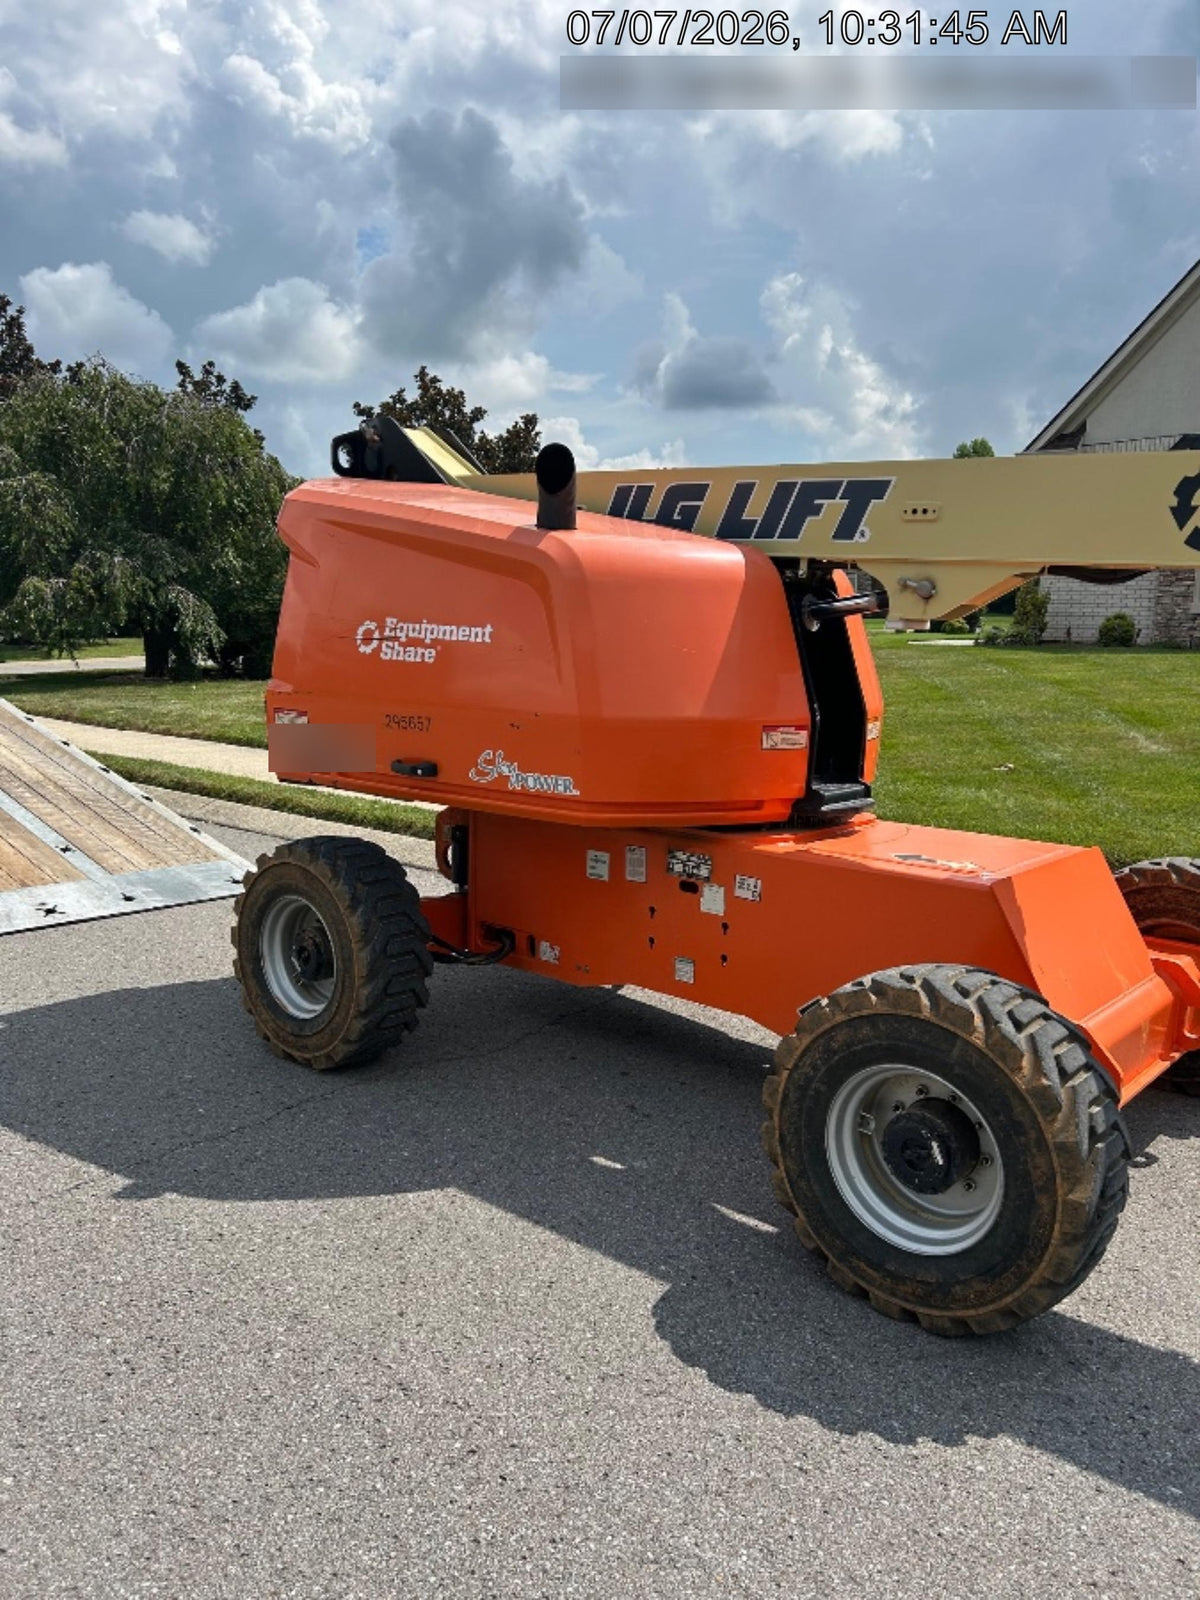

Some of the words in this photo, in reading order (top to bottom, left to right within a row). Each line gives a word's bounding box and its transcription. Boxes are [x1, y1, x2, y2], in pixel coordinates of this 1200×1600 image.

[714, 477, 896, 542] LIFT
[384, 617, 493, 643] Equipment
[380, 641, 436, 663] Share
[384, 713, 432, 732] 295657
[469, 750, 518, 789] Sky
[514, 772, 575, 794] POWER
